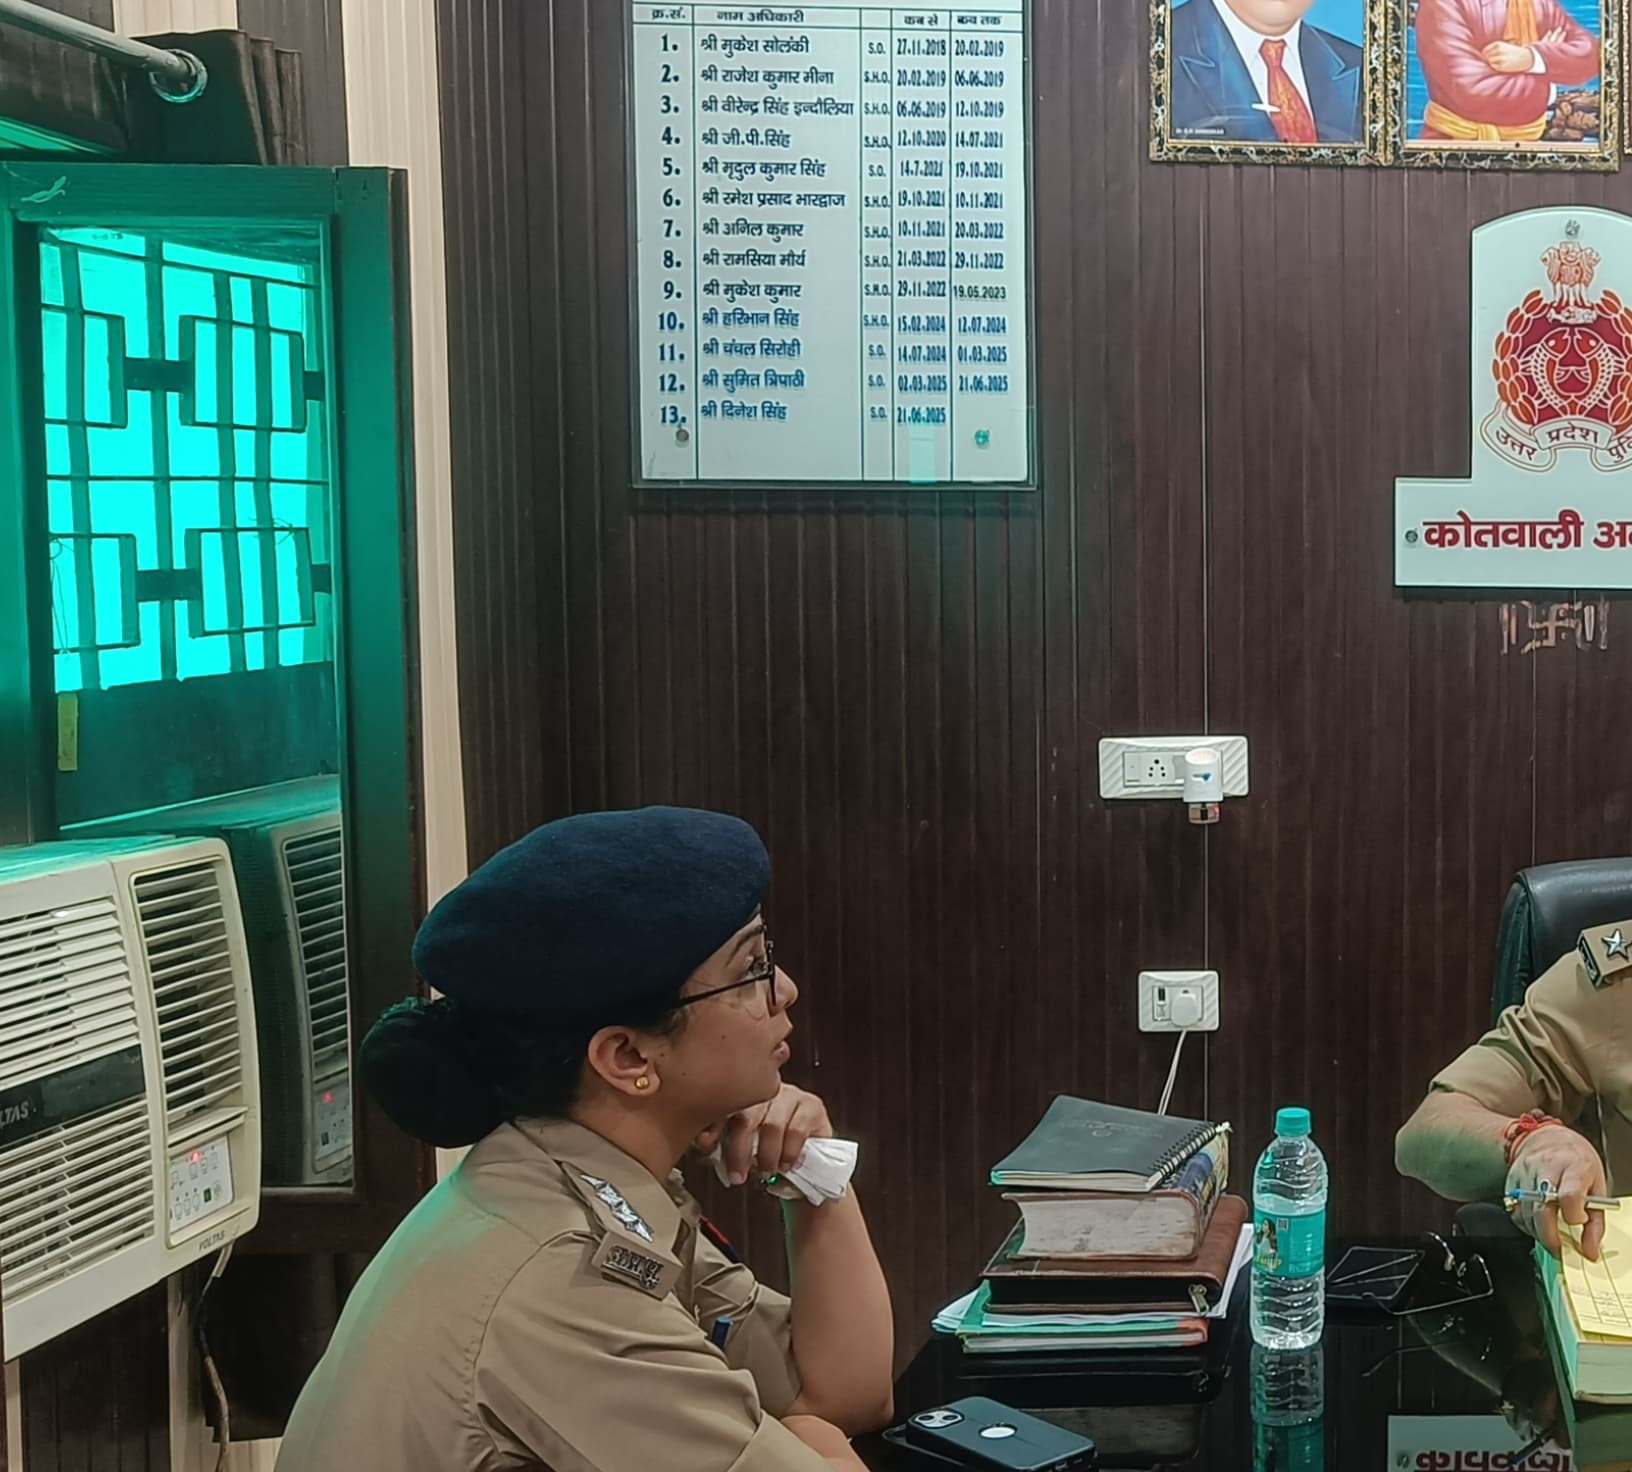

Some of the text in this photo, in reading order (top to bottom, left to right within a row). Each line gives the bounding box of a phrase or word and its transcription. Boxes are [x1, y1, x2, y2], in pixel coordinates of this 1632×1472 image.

[661, 33, 679, 51] 1.
[700, 34, 718, 50] श्री
[720, 34, 760, 58] मुकेश
[762, 35, 810, 53] सोलंकी
[661, 63, 680, 82] 2.
[700, 65, 719, 81] श्री
[721, 65, 760, 82] राजेश
[762, 70, 801, 89] कुमार
[802, 66, 835, 83] मीना
[660, 94, 680, 113] 3.
[701, 95, 719, 112] श्री
[762, 95, 790, 115] सिंह
[661, 125, 681, 144] 4.
[701, 127, 719, 144] श्री
[662, 157, 681, 176] 5.
[701, 157, 719, 173] श्री
[759, 162, 798, 181] कुमार
[799, 157, 827, 177] सिंह
[662, 187, 681, 207] 6.
[702, 187, 720, 204] श्री
[722, 187, 754, 205] रमेश
[756, 192, 793, 207] प्रसाद
[663, 218, 682, 237] 7.
[702, 217, 720, 234] श्री
[722, 218, 764, 236] अनिल
[766, 223, 804, 243] कुमार
[663, 249, 682, 268] 8.
[702, 248, 720, 265] श्री
[722, 248, 777, 266] रामसिया
[663, 280, 682, 299] 9.
[702, 279, 721, 295] श्री
[723, 279, 761, 302] मुकेश
[763, 284, 802, 303] कुमार
[658, 311, 685, 330] 10.
[701, 308, 719, 324] श्री
[722, 308, 771, 326] हरिभान
[773, 307, 800, 326] सिंह
[658, 342, 685, 361] 11.
[702, 339, 720, 355] श्री
[659, 373, 686, 392] 12.
[701, 369, 719, 387] श्री
[722, 368, 761, 393] सुमित
[660, 405, 687, 425] 13.
[700, 400, 718, 417] श्री
[720, 400, 758, 418] दिनेश
[760, 400, 788, 419] सिंह
[1496, 426, 1537, 461] उत्तर
[1546, 422, 1598, 444] प्रदेश
[1423, 509, 1584, 549] कोतवाली
[0, 1101, 29, 1128] LTAS
